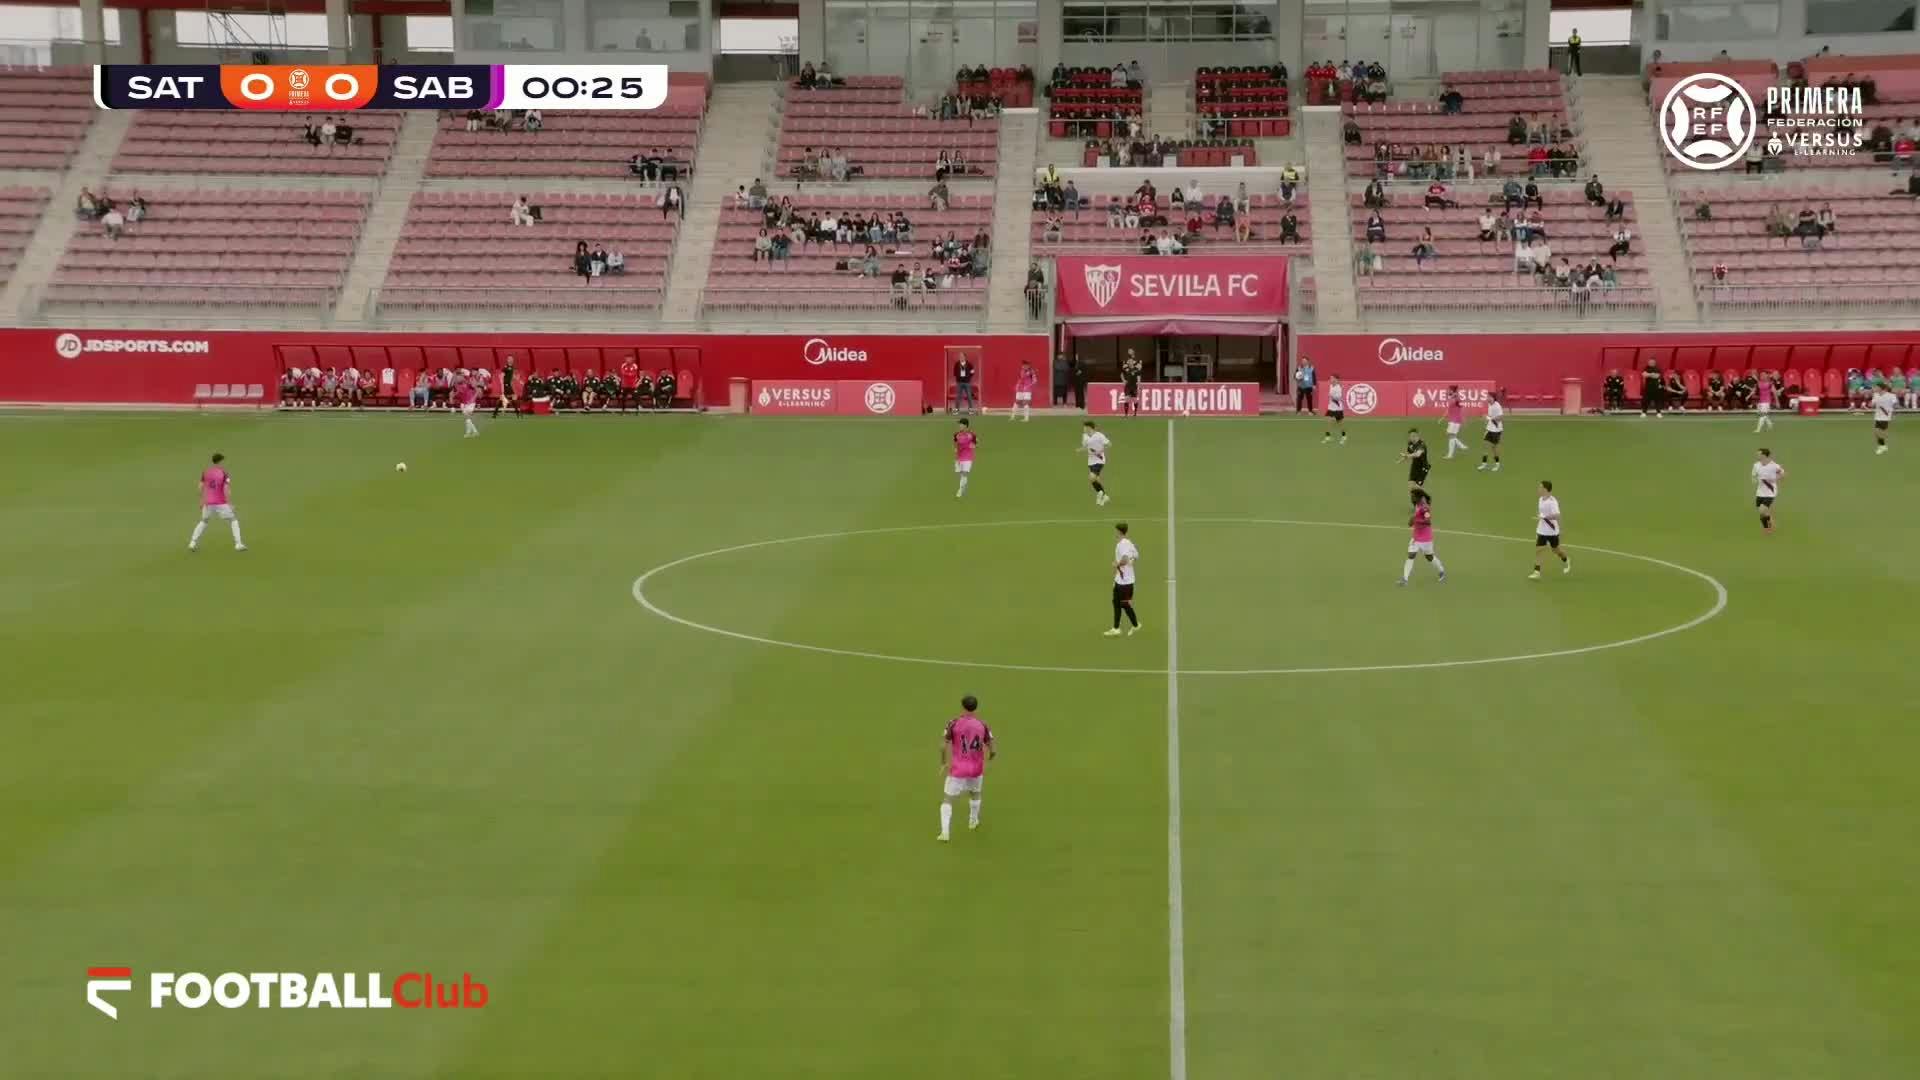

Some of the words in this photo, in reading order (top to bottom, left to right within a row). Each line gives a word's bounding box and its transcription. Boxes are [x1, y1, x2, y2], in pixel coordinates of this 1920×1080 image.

[1130, 274, 1221, 297] SEVILLA
[1228, 274, 1259, 297] FC
[84, 339, 209, 353] JDSPORTS.COM
[809, 343, 867, 363] Midea
[1384, 343, 1444, 363] Midea
[772, 388, 831, 401] VERSUS
[1427, 389, 1489, 401] VESUS
[960, 734, 983, 754] 14
